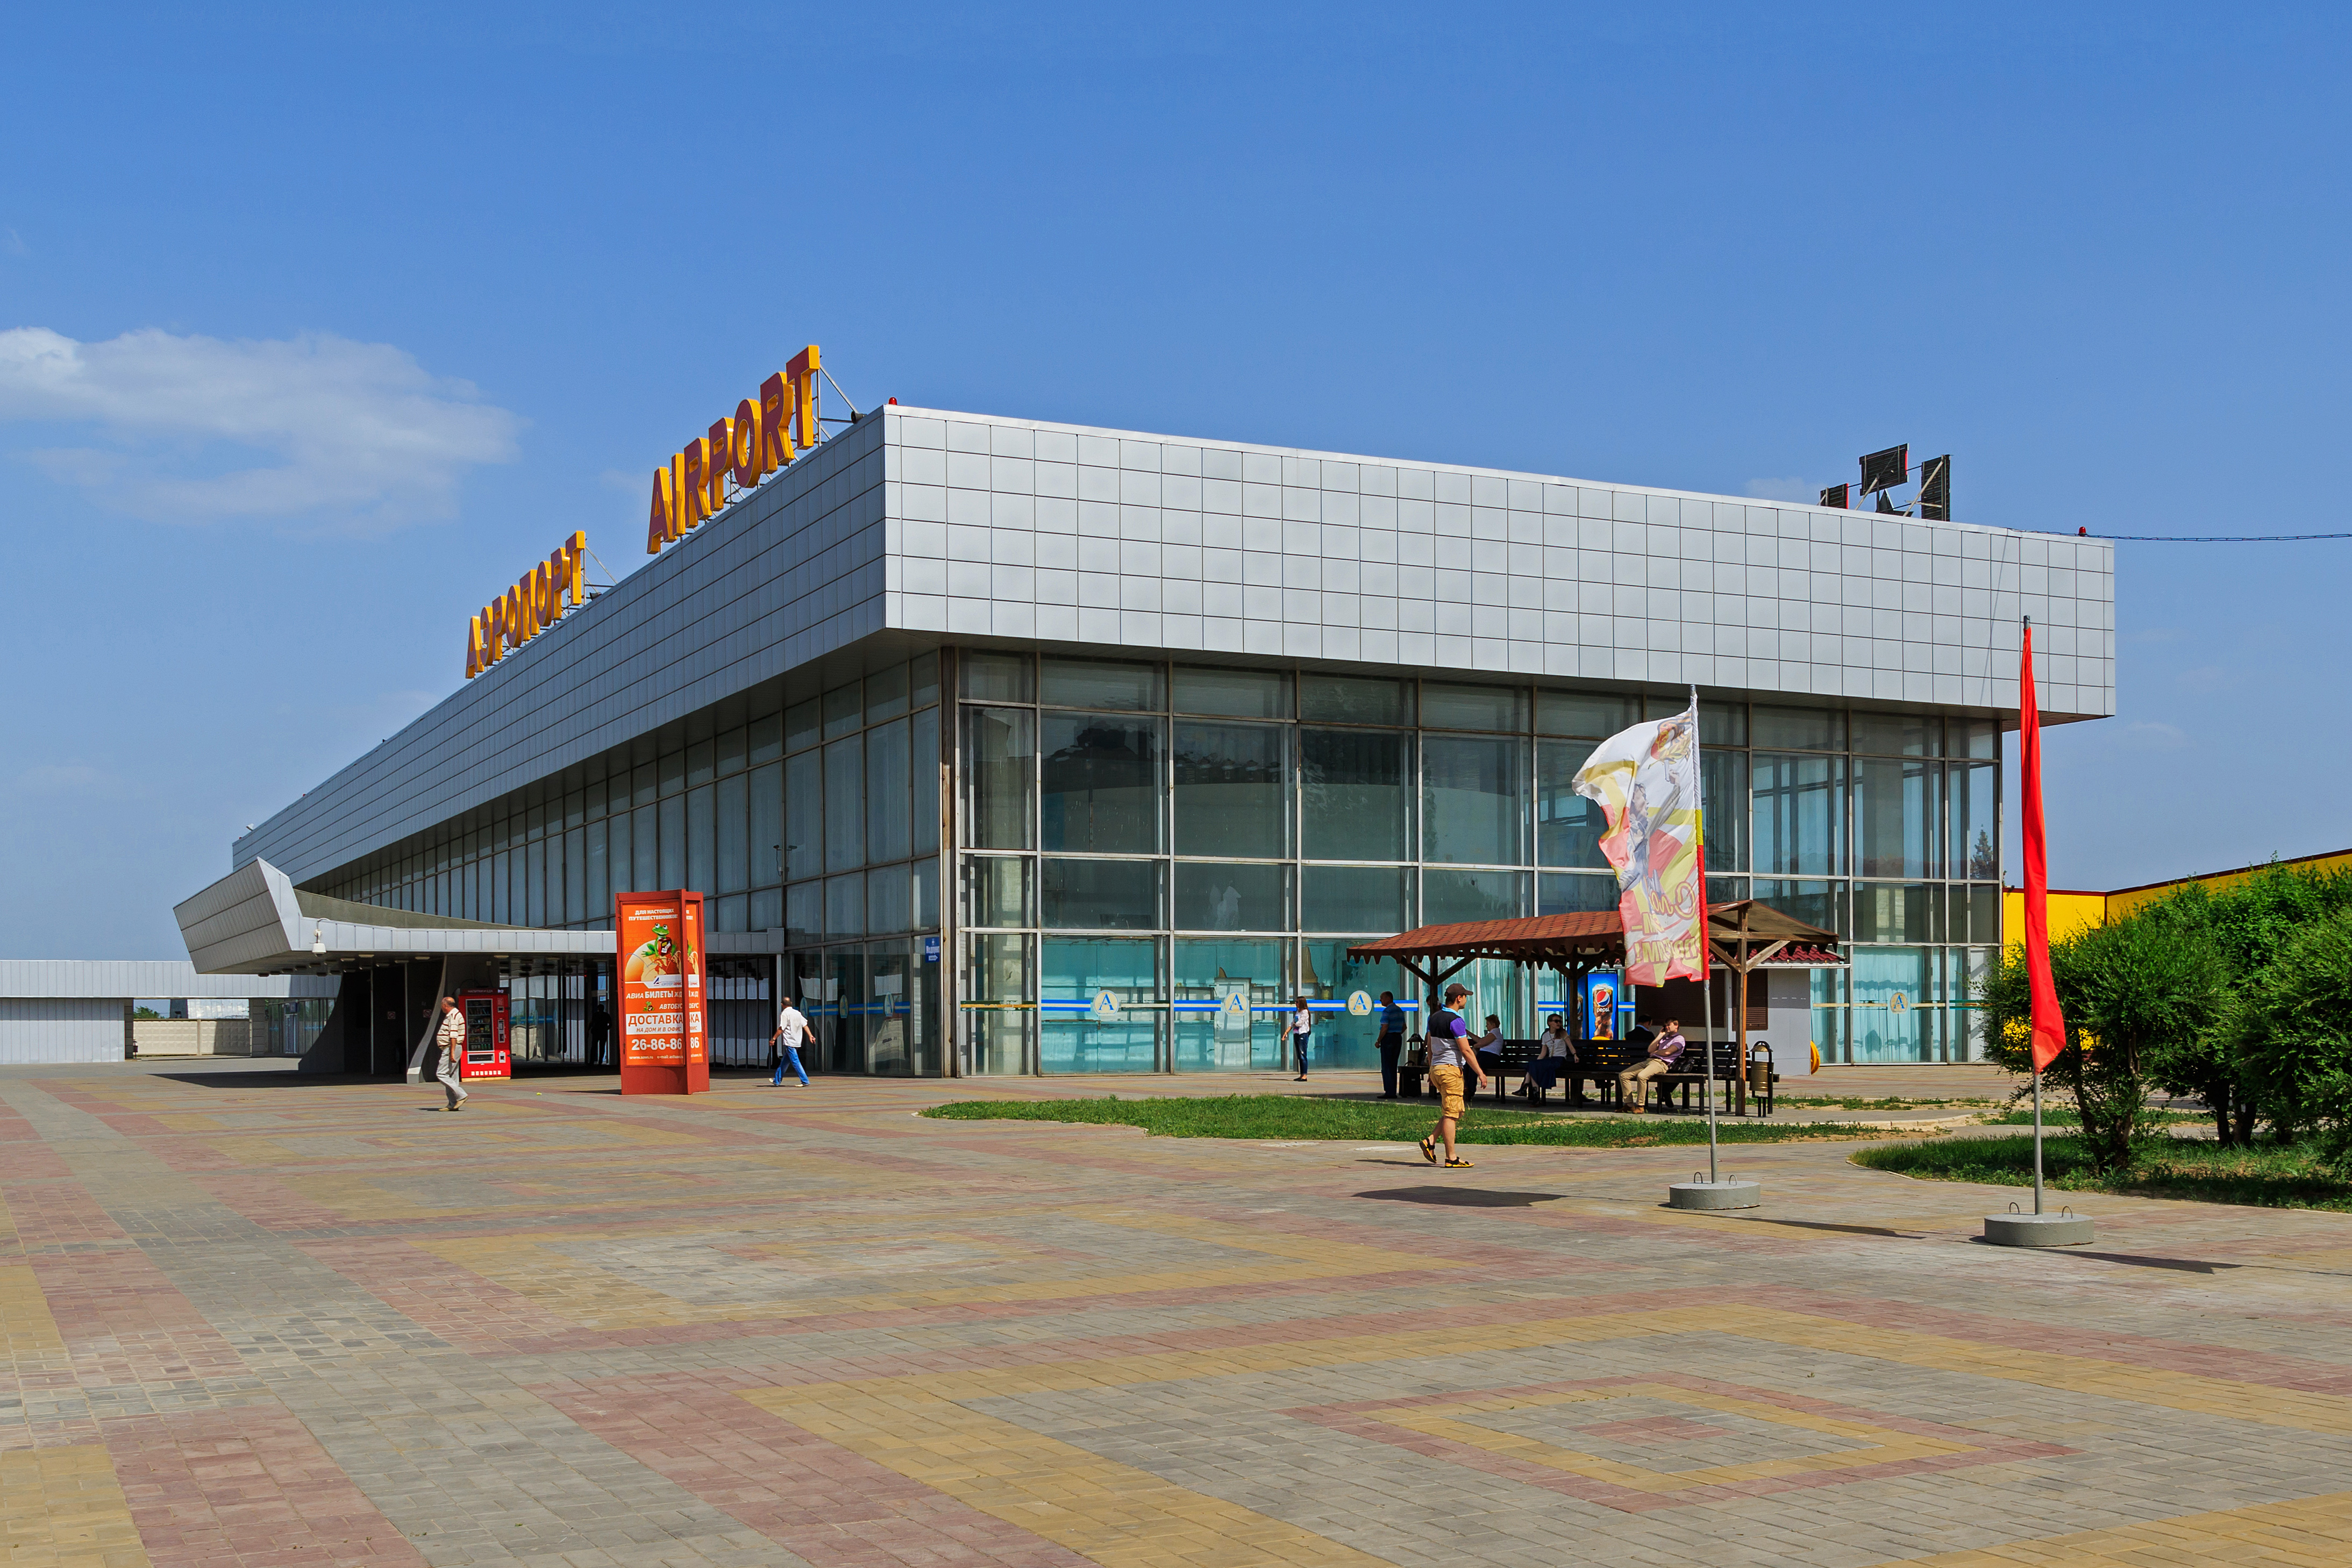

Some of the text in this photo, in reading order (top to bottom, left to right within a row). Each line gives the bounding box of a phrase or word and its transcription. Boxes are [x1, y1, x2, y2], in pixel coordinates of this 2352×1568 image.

[647, 345, 820, 554] AIRPORT
[466, 531, 586, 679] АЭРОПОРТ
[645, 990, 674, 999] БИЛЕТЫ
[628, 1014, 683, 1027] ДОСТАВКА
[631, 1038, 682, 1050] 26-86-86
